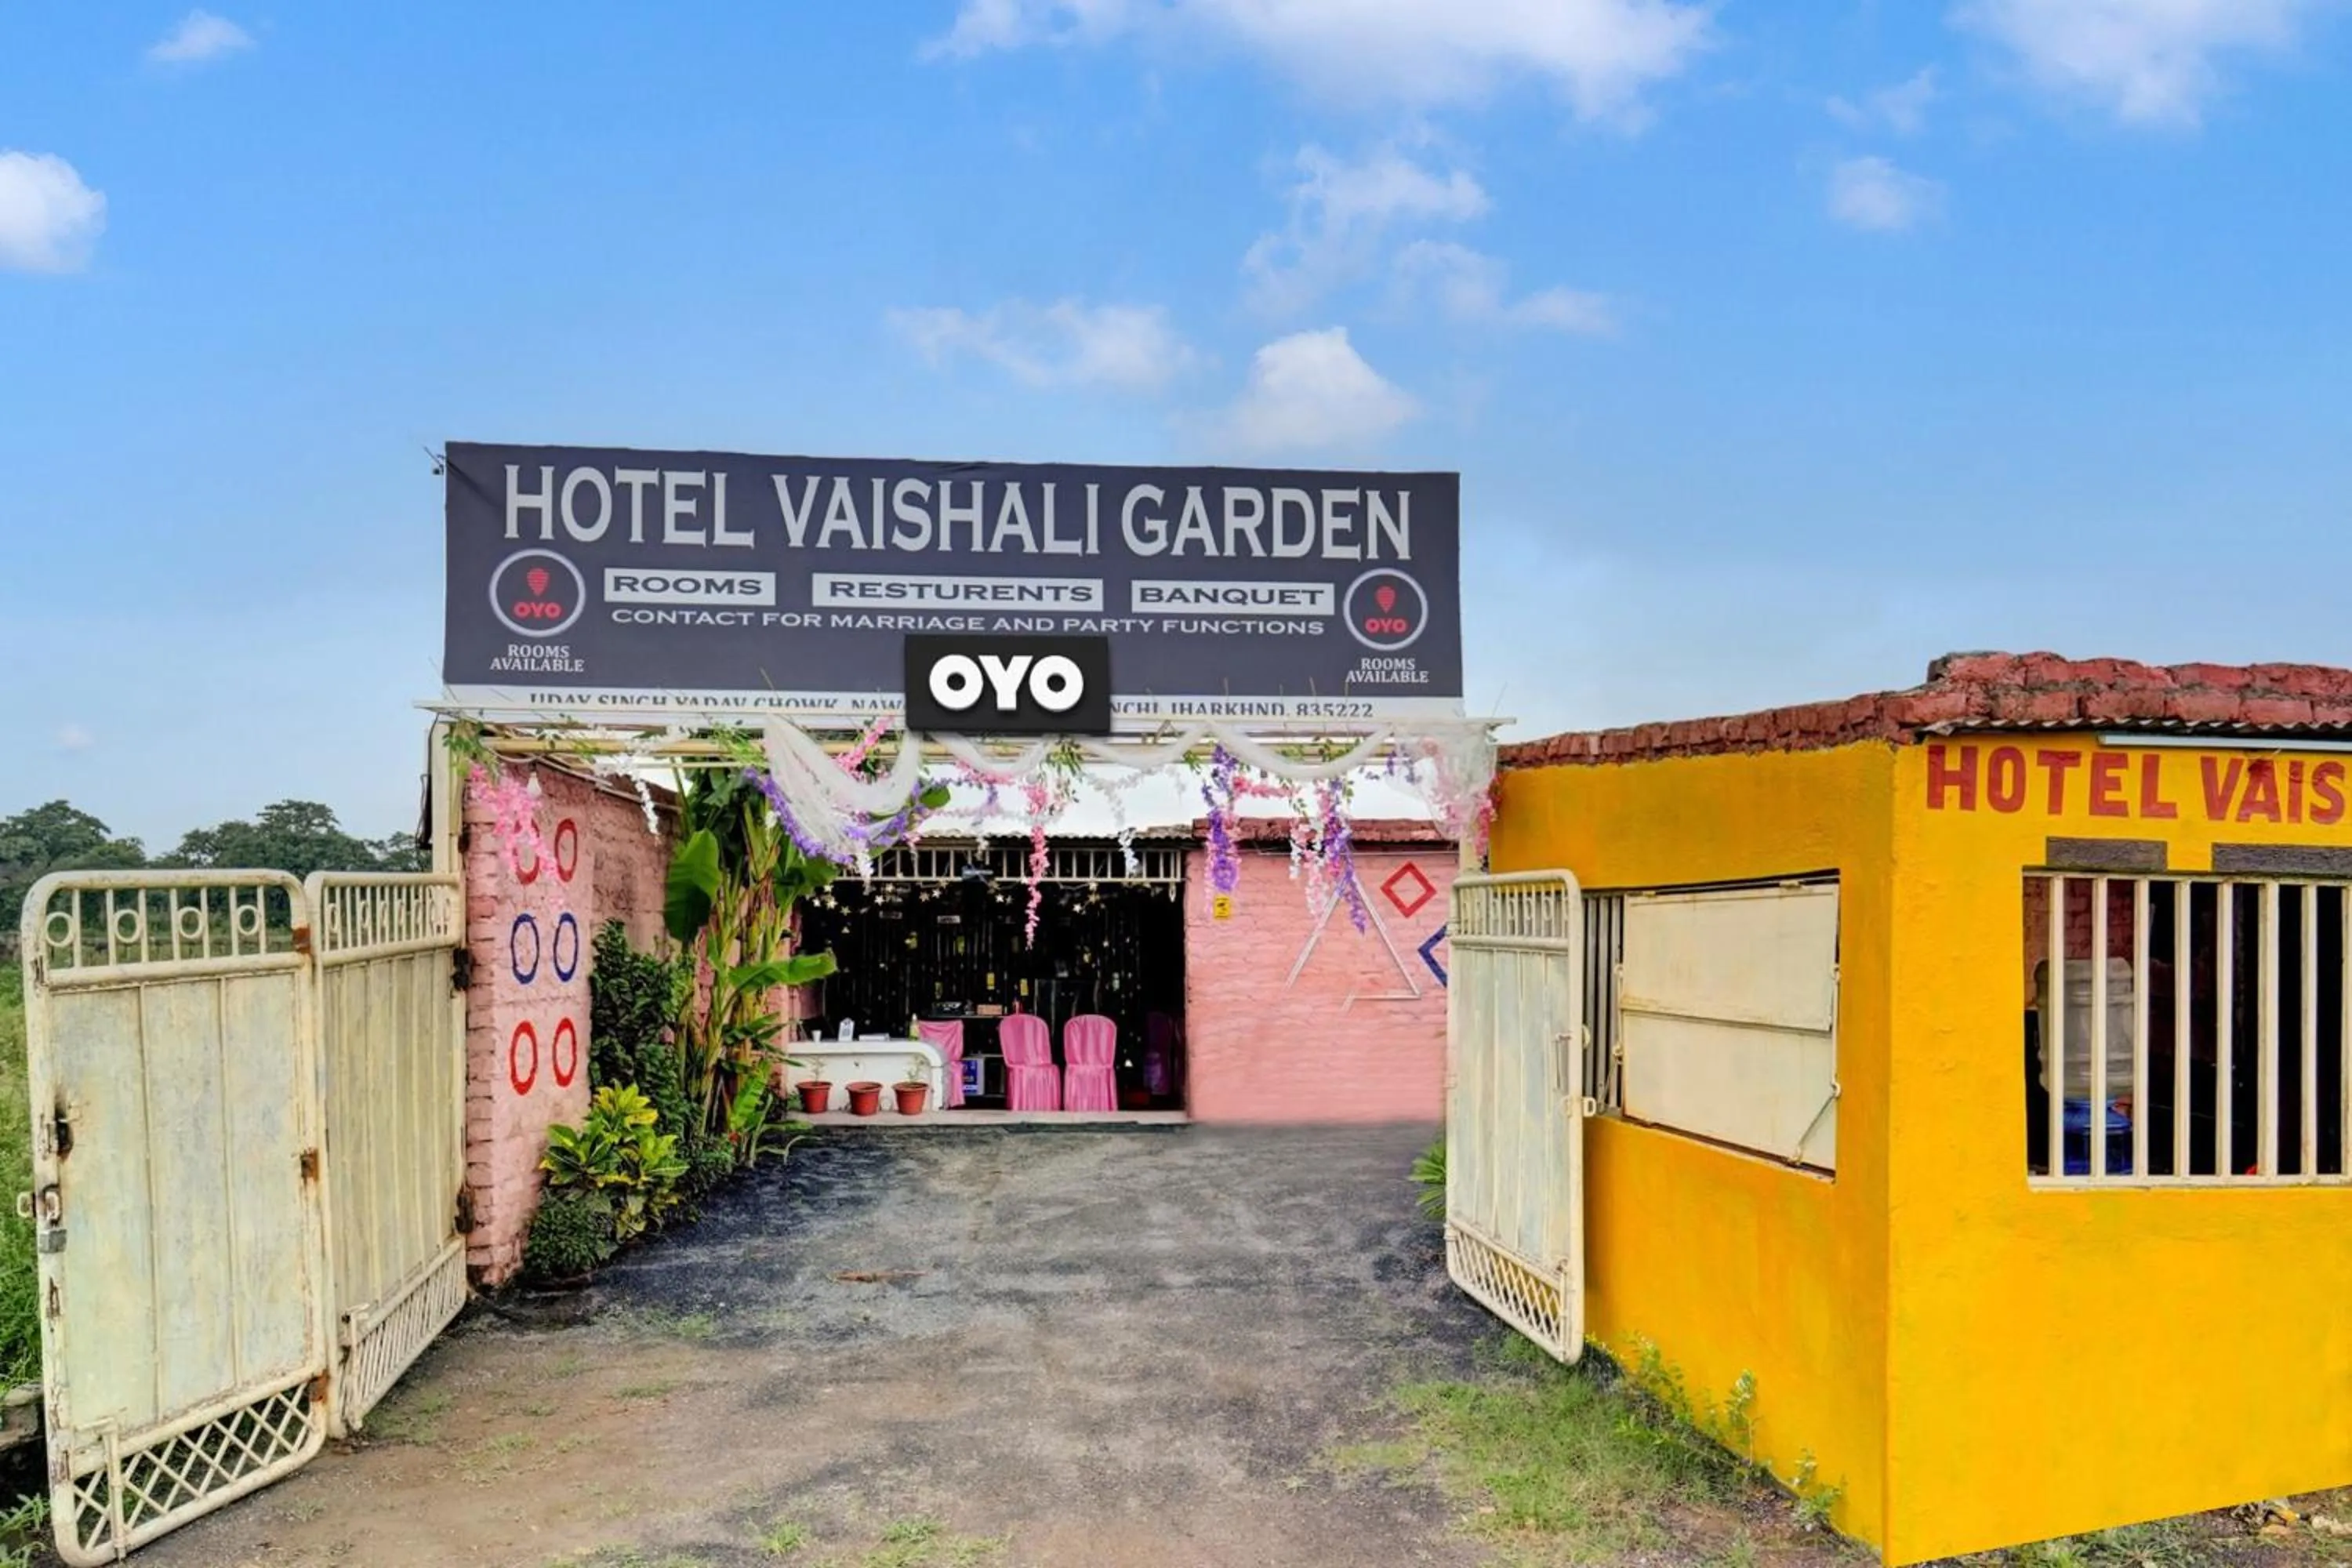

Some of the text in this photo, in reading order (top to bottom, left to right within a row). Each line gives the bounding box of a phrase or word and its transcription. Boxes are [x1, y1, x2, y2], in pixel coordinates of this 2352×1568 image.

[504, 464, 1412, 562] HOTEL VAISHALI GARDEN
[613, 575, 763, 595] ROOMS
[829, 581, 1094, 602] RESTURENTS
[1139, 586, 1325, 606] BANQUET
[514, 601, 561, 618] OYO
[612, 609, 1325, 635] CONTACT FOR MARRIAGE AND PARTY FUNCTIONS
[1365, 618, 1408, 633] OYO
[508, 644, 570, 659] ROOMS
[489, 657, 585, 672] AVAILABLE
[1361, 658, 1416, 671] ROOMS
[929, 654, 1084, 713] OYO
[1345, 670, 1430, 683] AVAILABLE
[1297, 702, 1373, 717] 835222
[1926, 744, 2346, 826] HOTEL VAIS
